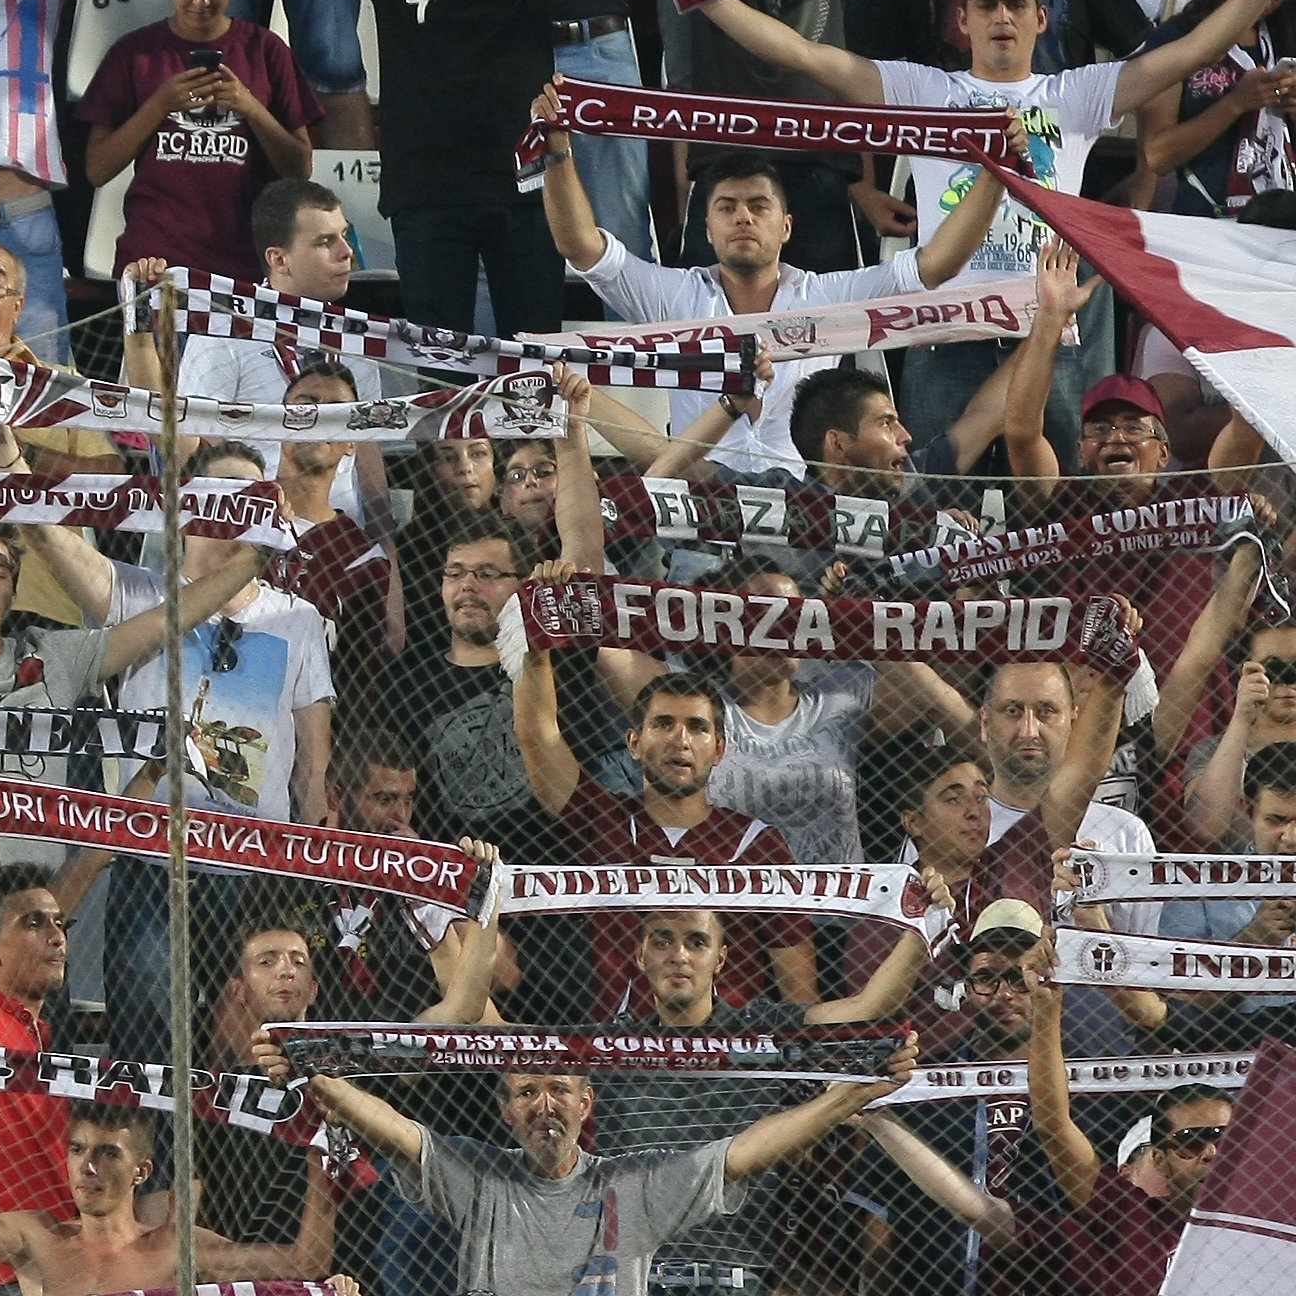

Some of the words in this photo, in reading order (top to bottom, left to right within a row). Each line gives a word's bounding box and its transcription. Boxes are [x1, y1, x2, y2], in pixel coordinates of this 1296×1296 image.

[156, 131, 187, 154] FC
[191, 130, 249, 155] RAPID
[633, 107, 760, 135] RAPID
[866, 293, 1022, 349] RAPID
[890, 521, 1070, 582] POVESTEA
[612, 582, 837, 653] FORZA
[872, 596, 1072, 653] RAPID
[281, 832, 466, 890] TUTUROR
